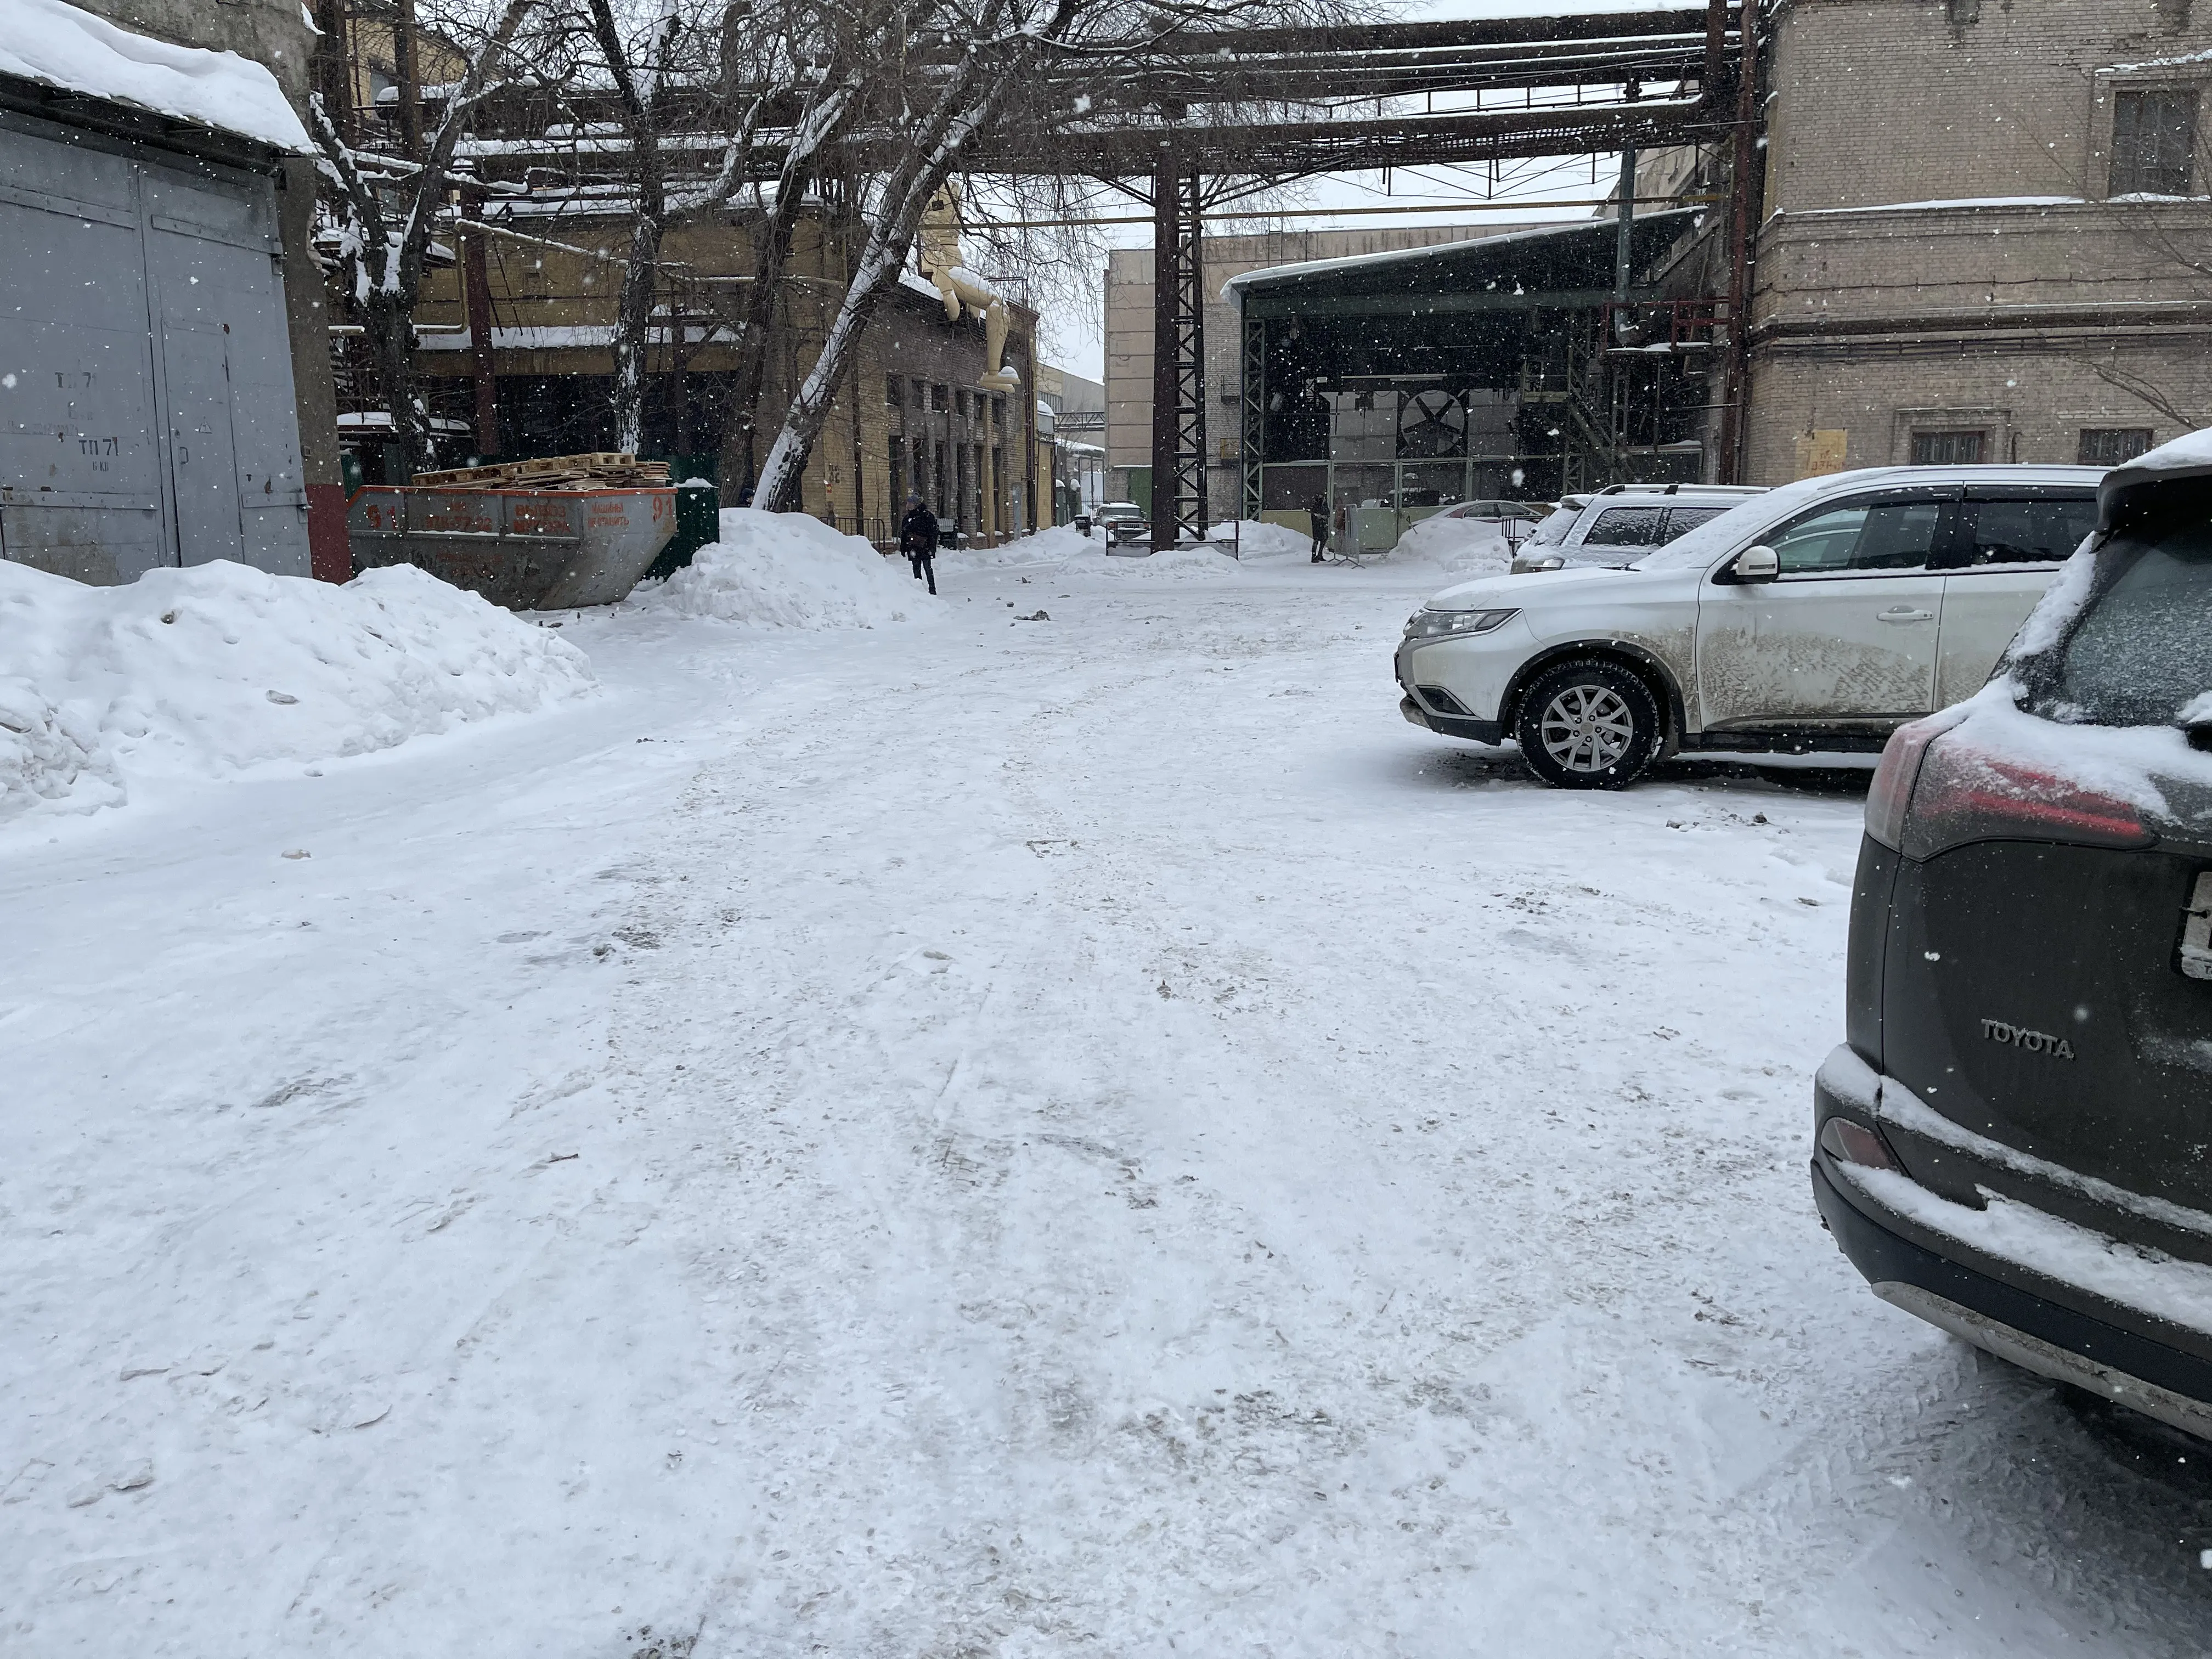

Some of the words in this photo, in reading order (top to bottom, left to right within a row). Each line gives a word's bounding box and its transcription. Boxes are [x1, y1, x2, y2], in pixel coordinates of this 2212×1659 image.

[103, 436, 119, 456] 71
[652, 496, 673, 522] 91
[1981, 1018, 2075, 1061] TOYOTA
